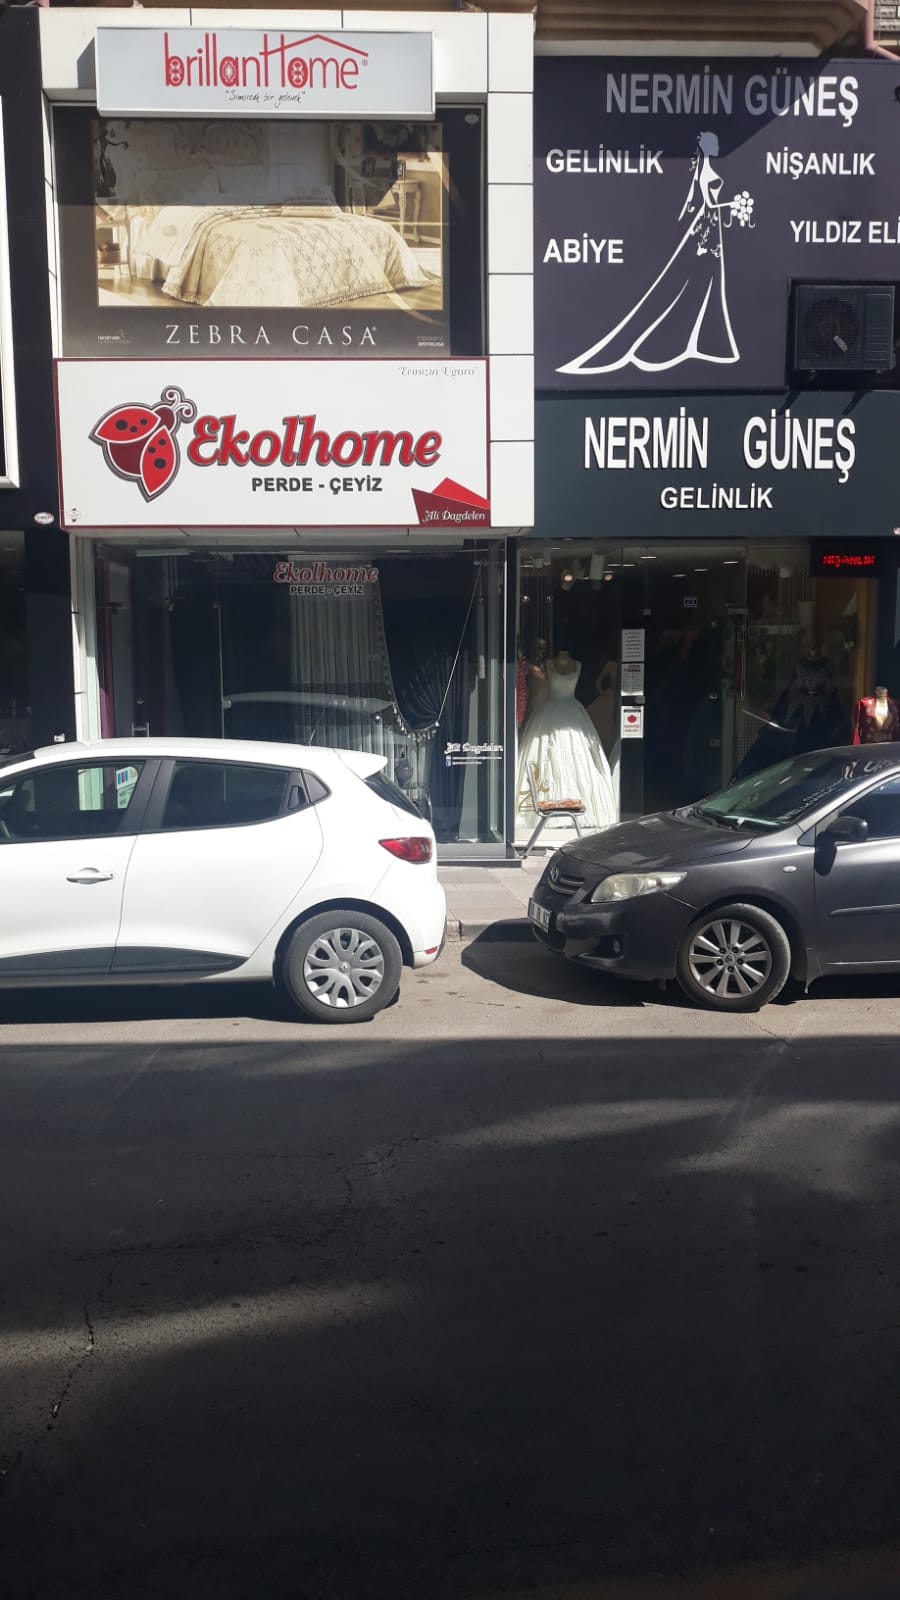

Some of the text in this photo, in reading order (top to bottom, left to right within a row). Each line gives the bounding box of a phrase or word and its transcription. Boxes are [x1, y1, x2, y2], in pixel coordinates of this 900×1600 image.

[605, 65, 859, 127] NERMİN GÜNEŞ
[545, 144, 664, 175] GELİNLİK
[766, 151, 875, 180] NİŞANLIK
[789, 220, 862, 244] YILDIZ
[543, 232, 624, 265] ABİYE
[165, 324, 271, 345] ZEBRA
[187, 414, 442, 467] Ekolhome
[584, 406, 857, 484] NERMİN GÜNEŞ
[251, 476, 314, 493] PERDE
[330, 474, 383, 497] ÇEYİZ
[660, 482, 774, 511] GELİNLİK
[273, 561, 379, 584] Ekolhome
[289, 585, 325, 596] PERDE
[333, 584, 364, 597] ÇEYİZ
